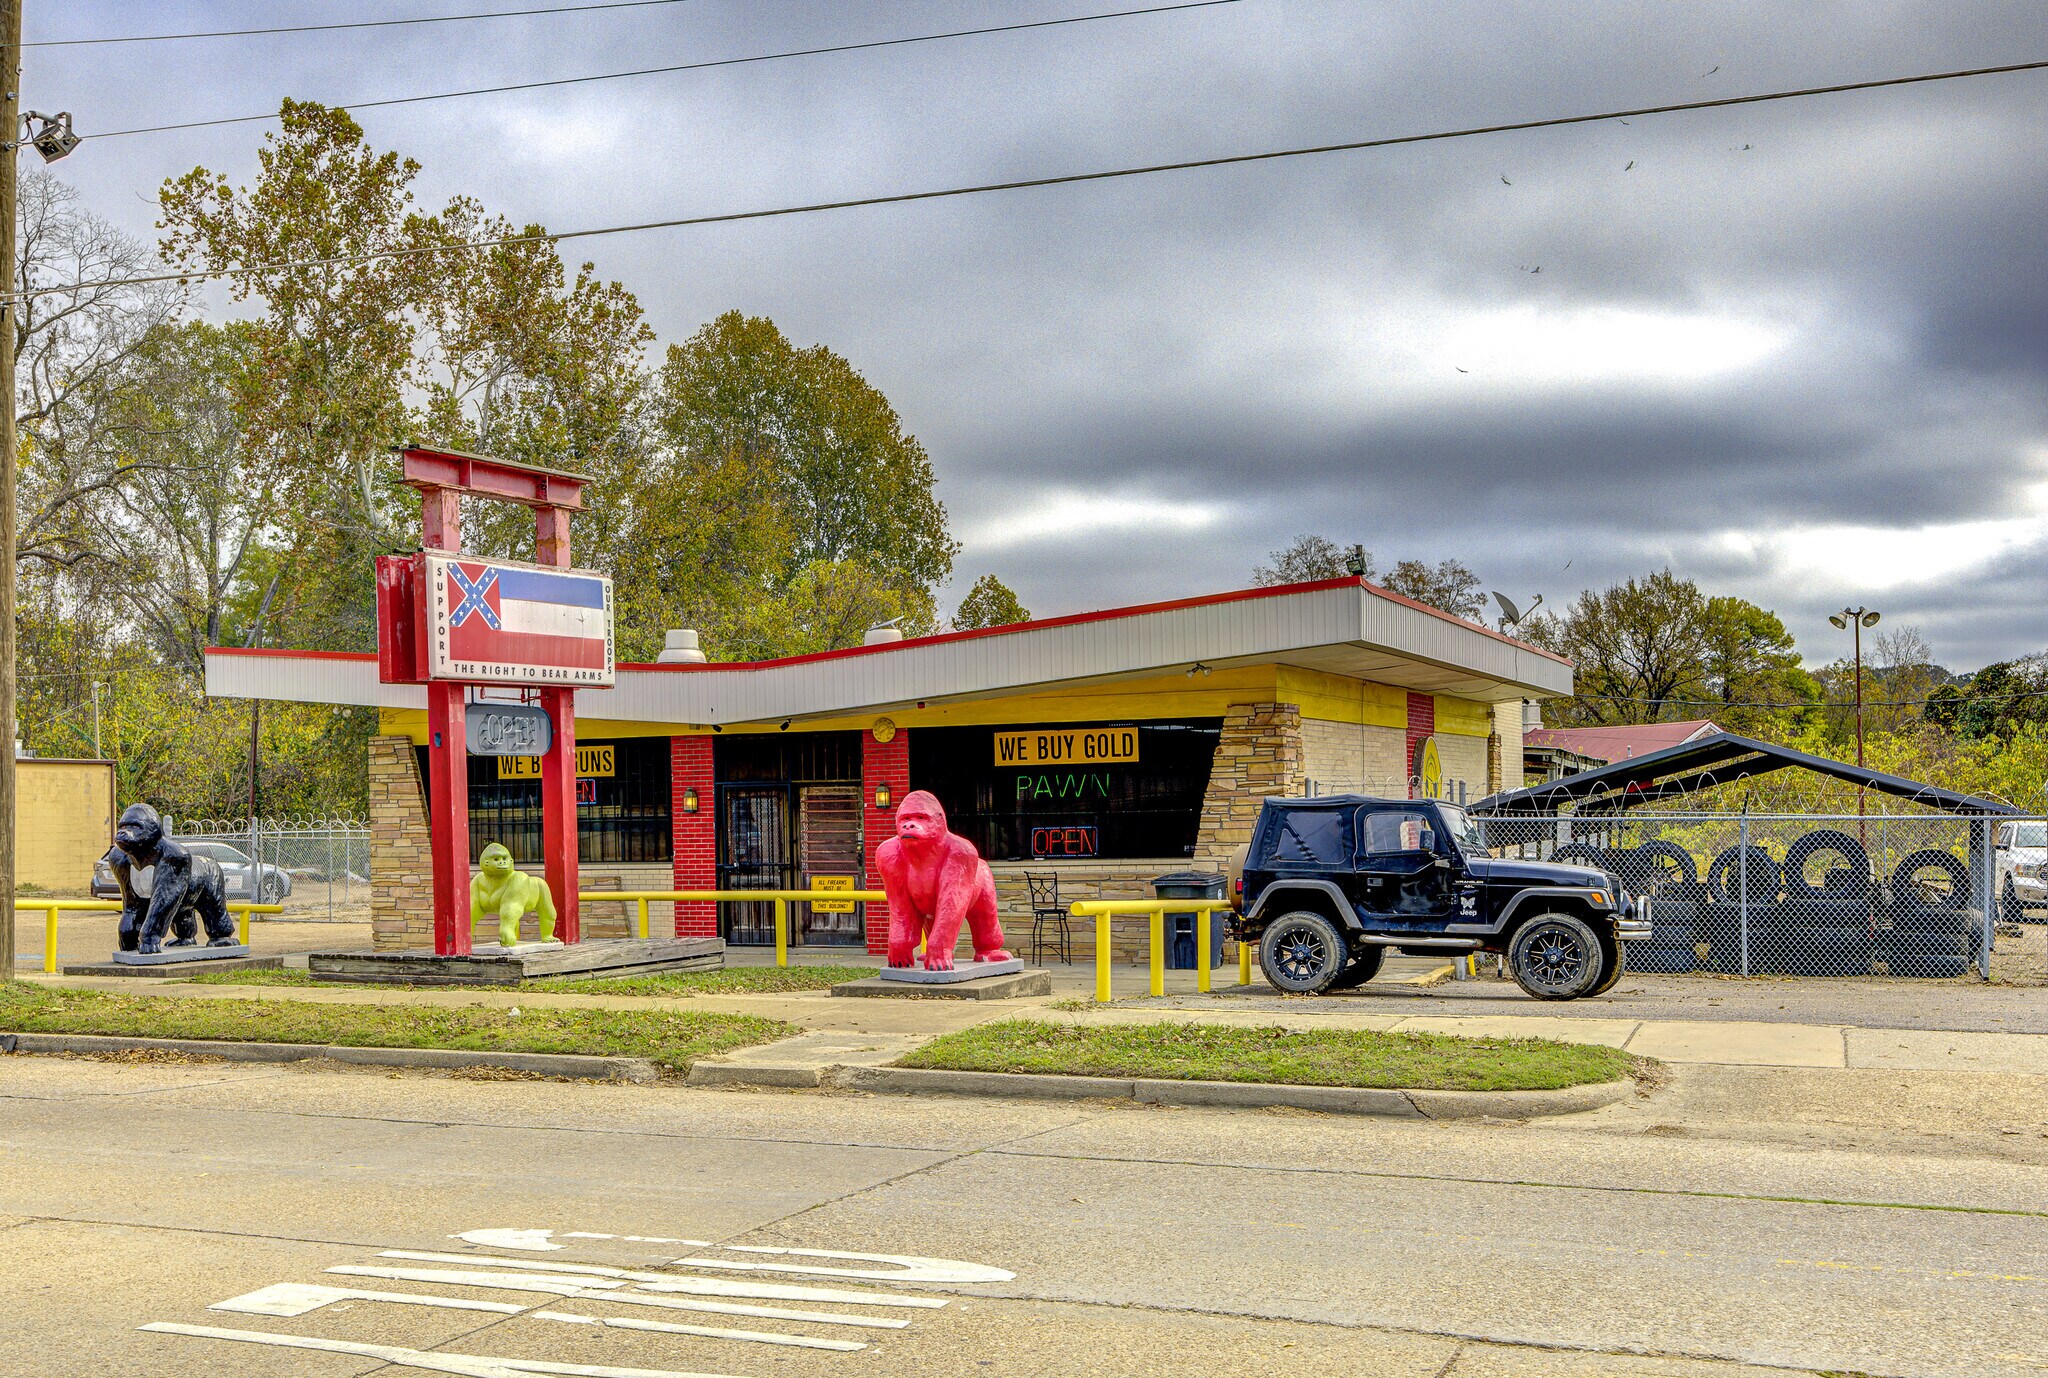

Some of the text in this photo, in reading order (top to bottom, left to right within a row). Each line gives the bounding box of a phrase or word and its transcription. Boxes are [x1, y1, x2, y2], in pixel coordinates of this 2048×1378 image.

[437, 567, 445, 665] SUPPORT
[454, 664, 602, 681] THE RIGHT TO BEAR ARMS
[487, 714, 537, 746] OPEN
[999, 732, 1134, 761] WE BUY GOLD
[501, 756, 523, 775] WE
[575, 750, 612, 773] UNS
[1016, 773, 1110, 800] PAWN
[1034, 828, 1096, 854] OPEN
[1459, 909, 1478, 917] Jeep
